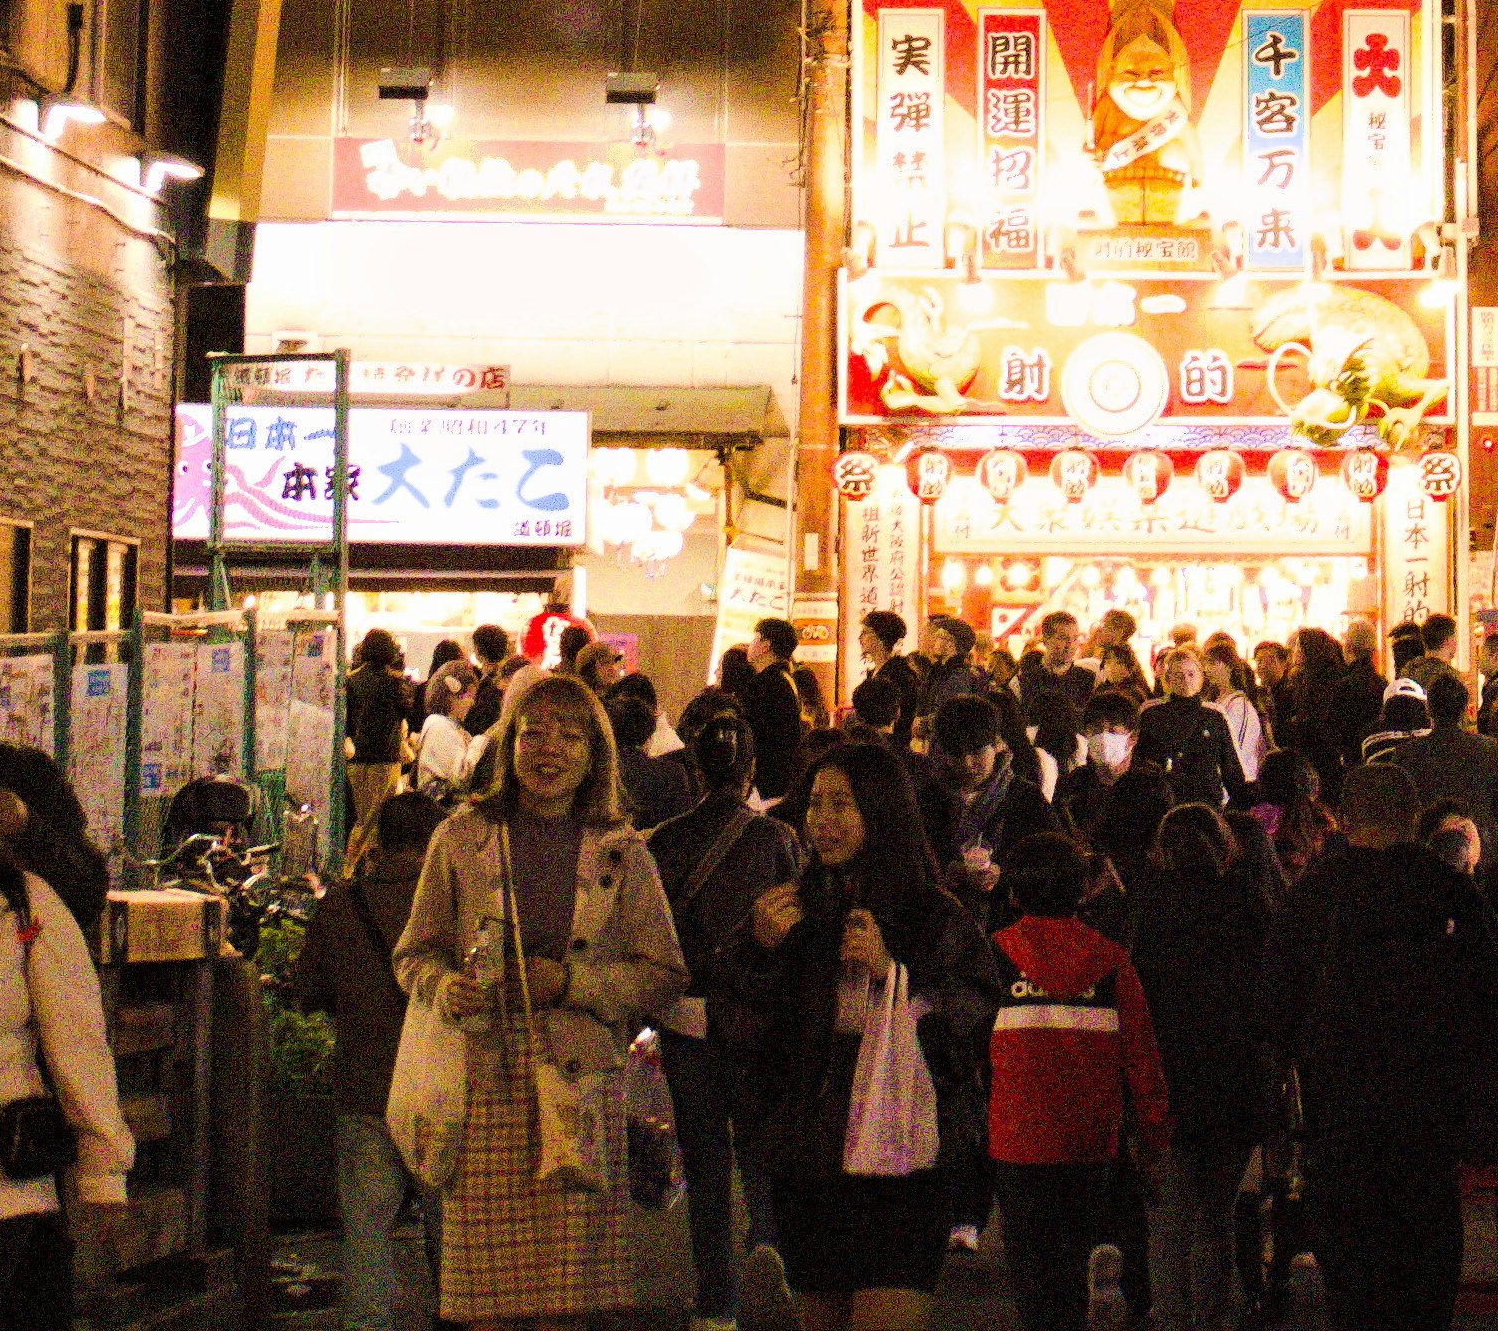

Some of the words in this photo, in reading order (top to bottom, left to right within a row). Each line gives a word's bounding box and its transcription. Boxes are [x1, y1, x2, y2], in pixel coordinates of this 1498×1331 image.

[988, 34, 1034, 249] 開運招福
[1254, 33, 1298, 251] 千客万来
[225, 416, 337, 452] 日本一
[371, 443, 570, 512] 大たこ
